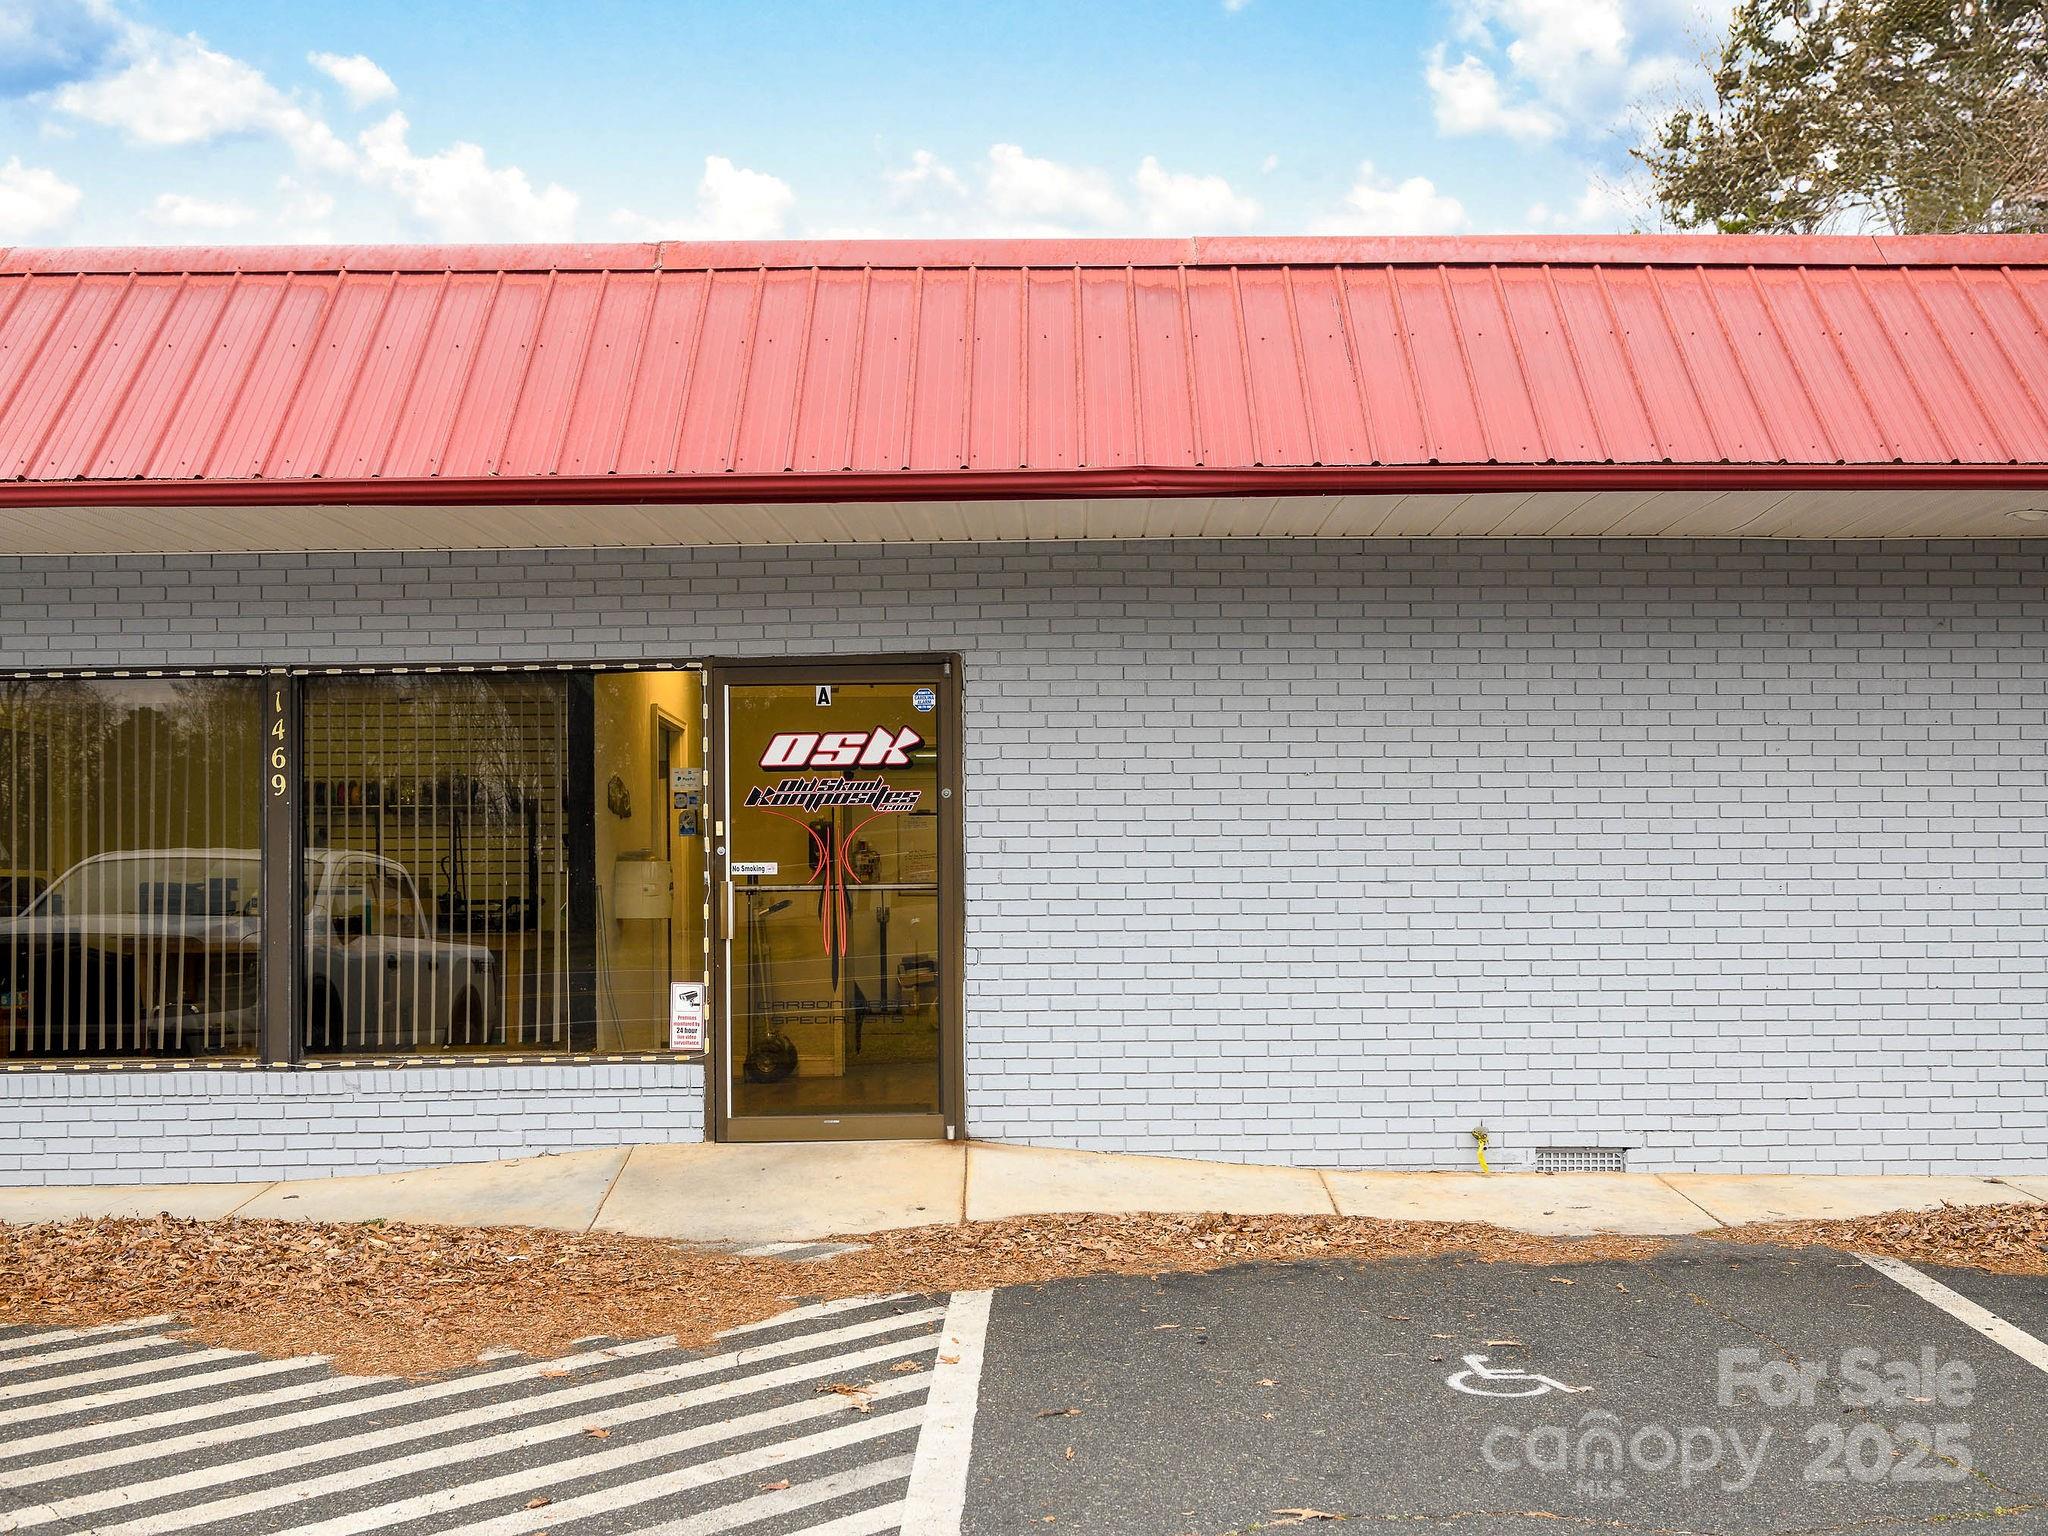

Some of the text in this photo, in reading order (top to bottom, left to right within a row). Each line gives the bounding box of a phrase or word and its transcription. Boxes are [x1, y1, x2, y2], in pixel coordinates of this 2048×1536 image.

[817, 687, 831, 705] A
[271, 691, 288, 797] 1469
[759, 725, 925, 771] OSK
[741, 865, 765, 873] Smoking
[758, 1001, 843, 1009] CARBON
[771, 1016, 905, 1024] SPECIALISTS
